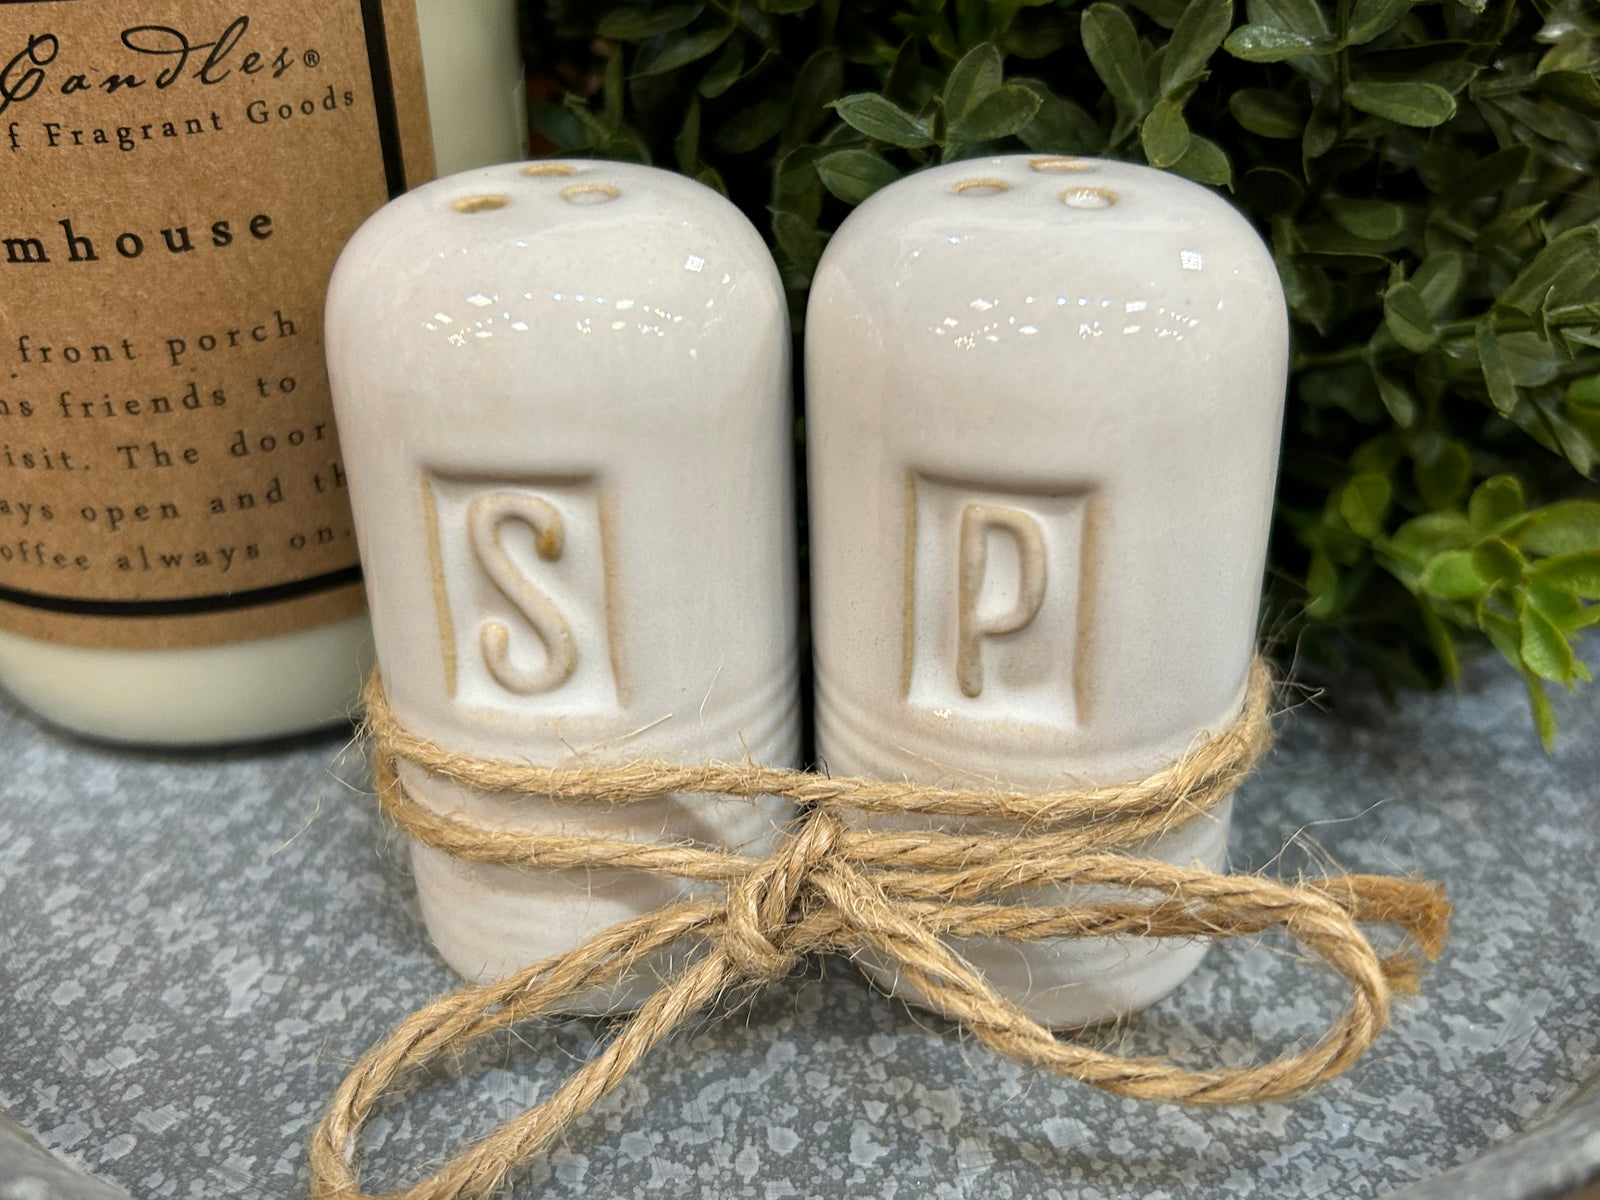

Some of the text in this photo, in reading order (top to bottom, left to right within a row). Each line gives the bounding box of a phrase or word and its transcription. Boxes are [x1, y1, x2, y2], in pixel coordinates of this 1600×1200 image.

[8, 85, 355, 151] f Fragrant Goods
[2, 213, 273, 263] mhouse
[18, 310, 297, 366] front porch
[59, 382, 227, 418] friends
[256, 376, 296, 398] to
[4, 422, 327, 472] isit. The door
[0, 500, 54, 527] ays
[81, 502, 180, 532] open
[210, 478, 285, 515] and
[0, 539, 90, 571] offee
[117, 543, 260, 573] always
[468, 494, 578, 696] S
[957, 504, 1047, 698] P
